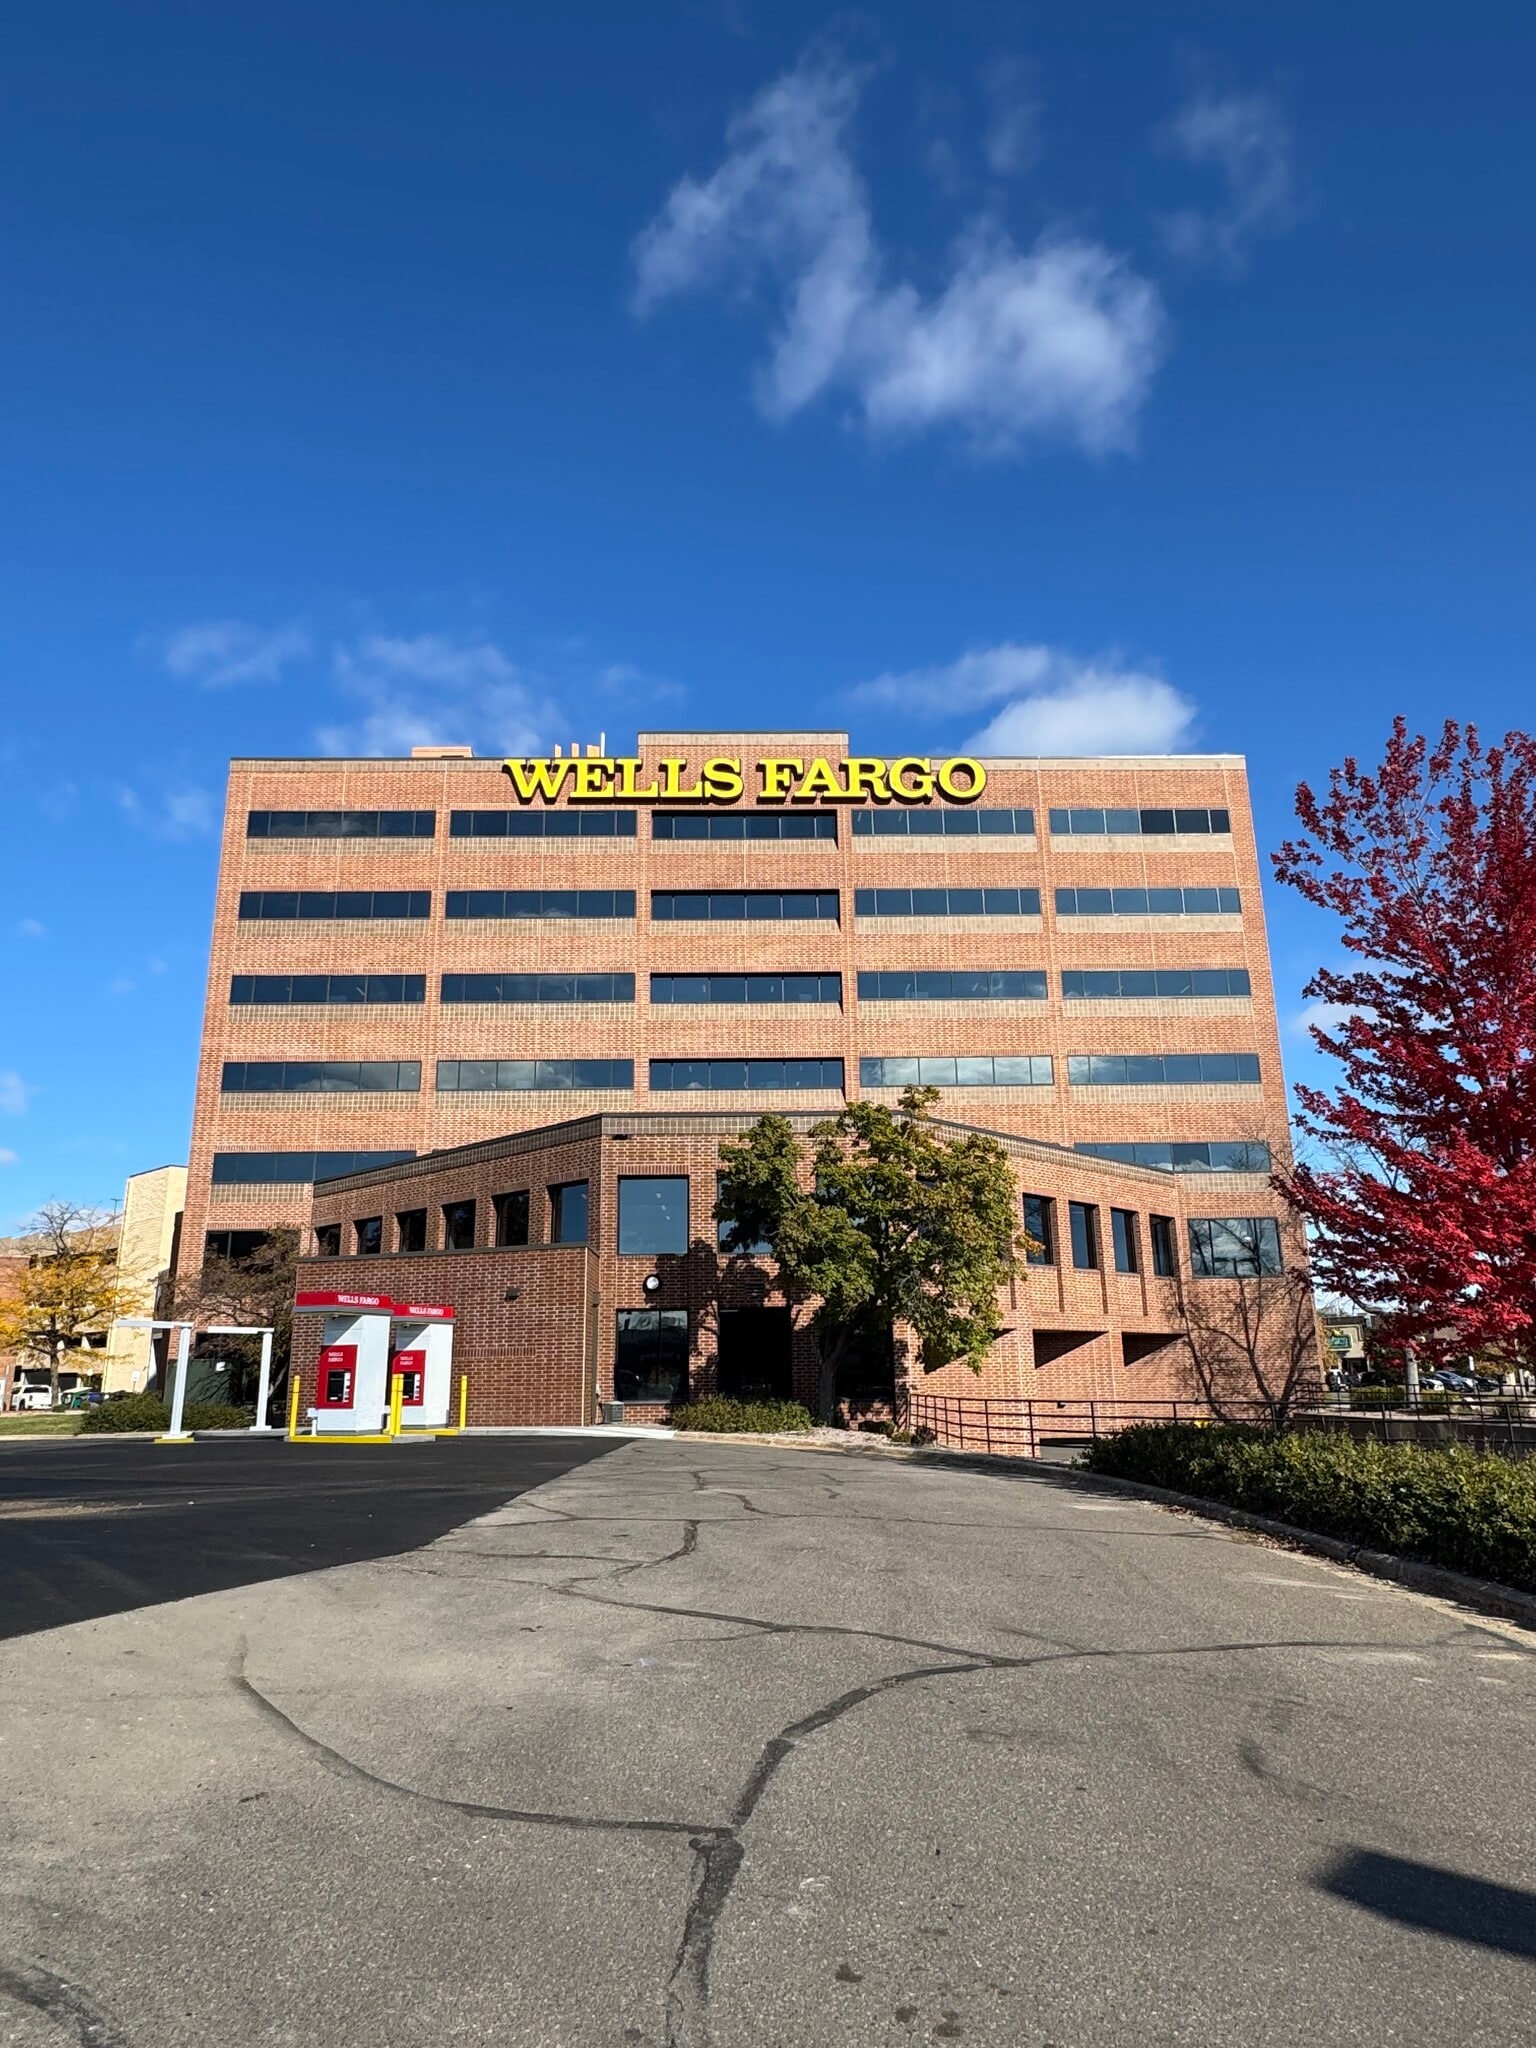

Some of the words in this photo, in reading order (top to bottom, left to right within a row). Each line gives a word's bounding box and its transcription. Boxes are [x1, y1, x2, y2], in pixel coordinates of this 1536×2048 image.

[504, 758, 744, 803] WELLS
[758, 757, 987, 803] FARGO
[337, 1294, 358, 1304] WELLS
[359, 1296, 380, 1305] FARGO
